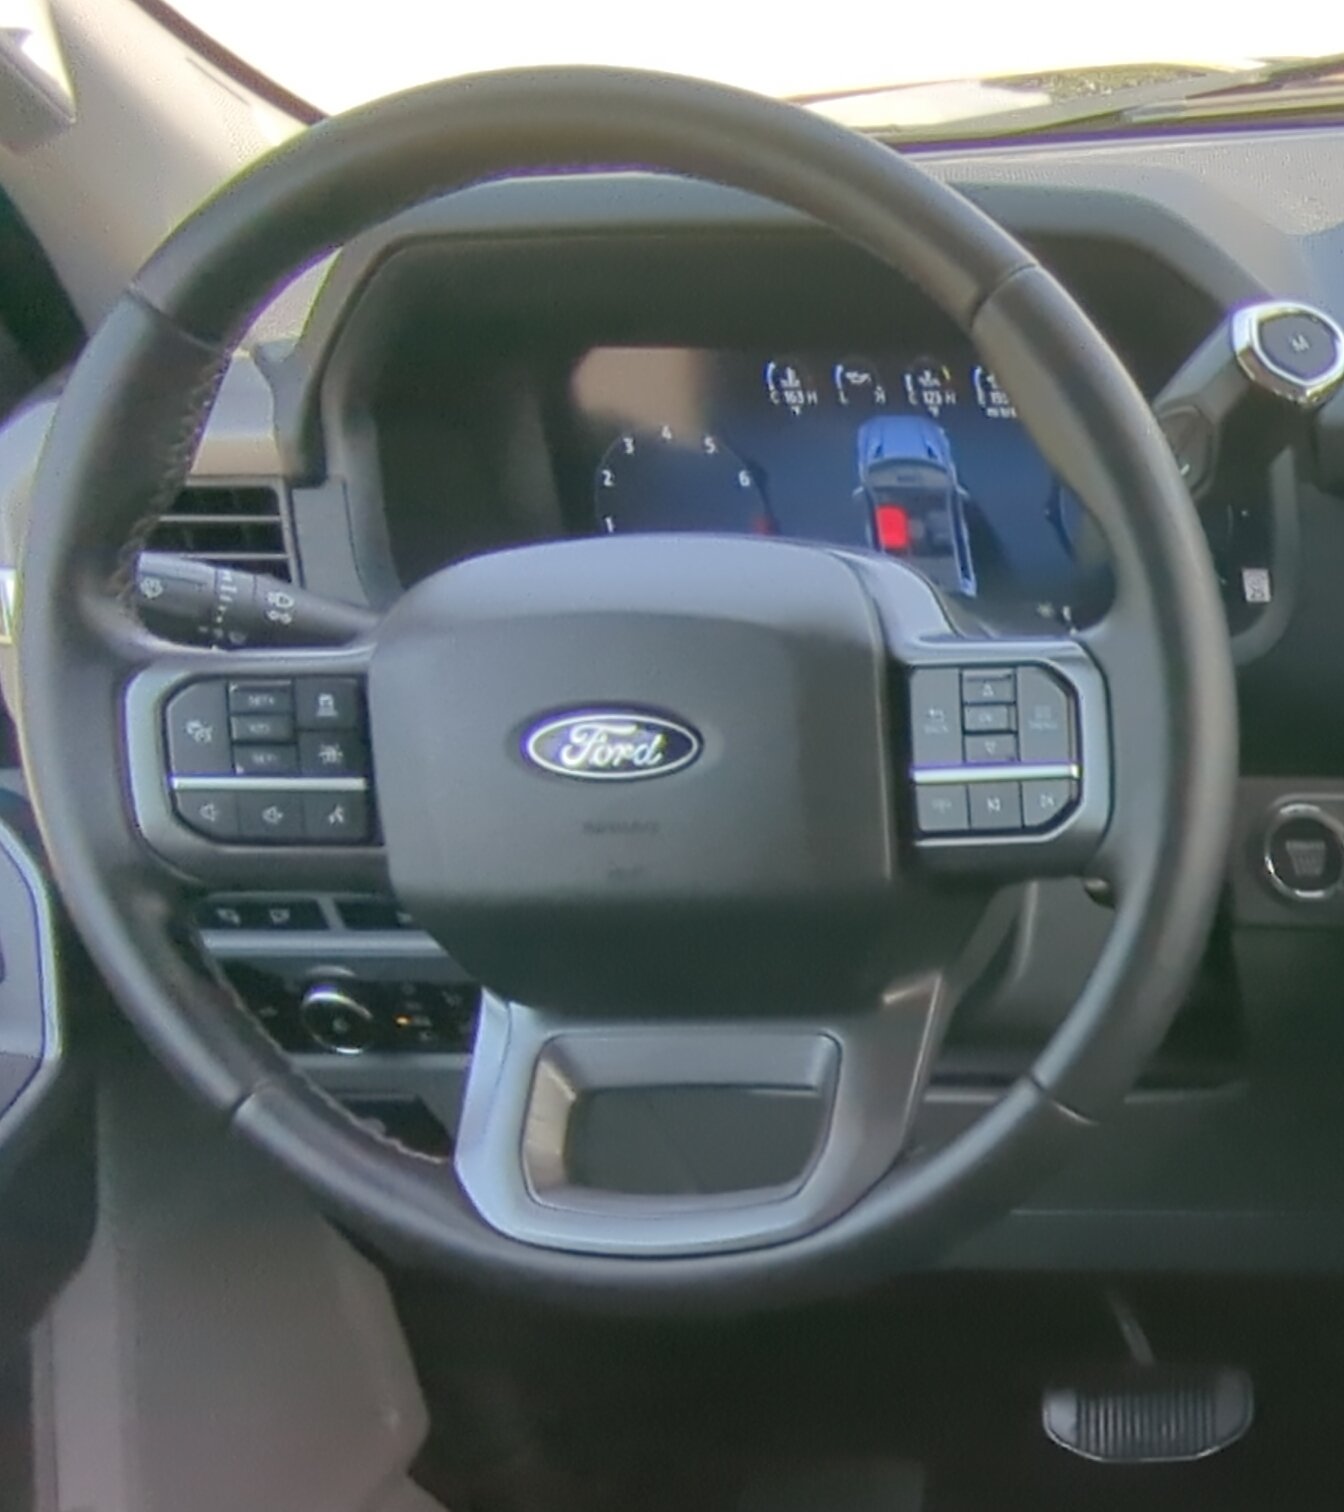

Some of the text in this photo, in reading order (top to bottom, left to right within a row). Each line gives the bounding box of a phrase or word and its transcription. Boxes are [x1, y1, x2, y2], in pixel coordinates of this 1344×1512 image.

[660, 424, 673, 440] 4
[623, 436, 636, 454] 3
[704, 436, 718, 454] 5
[601, 469, 614, 487] 2
[738, 469, 752, 487] 6
[604, 516, 615, 534] 1
[560, 723, 663, 767] Ford
